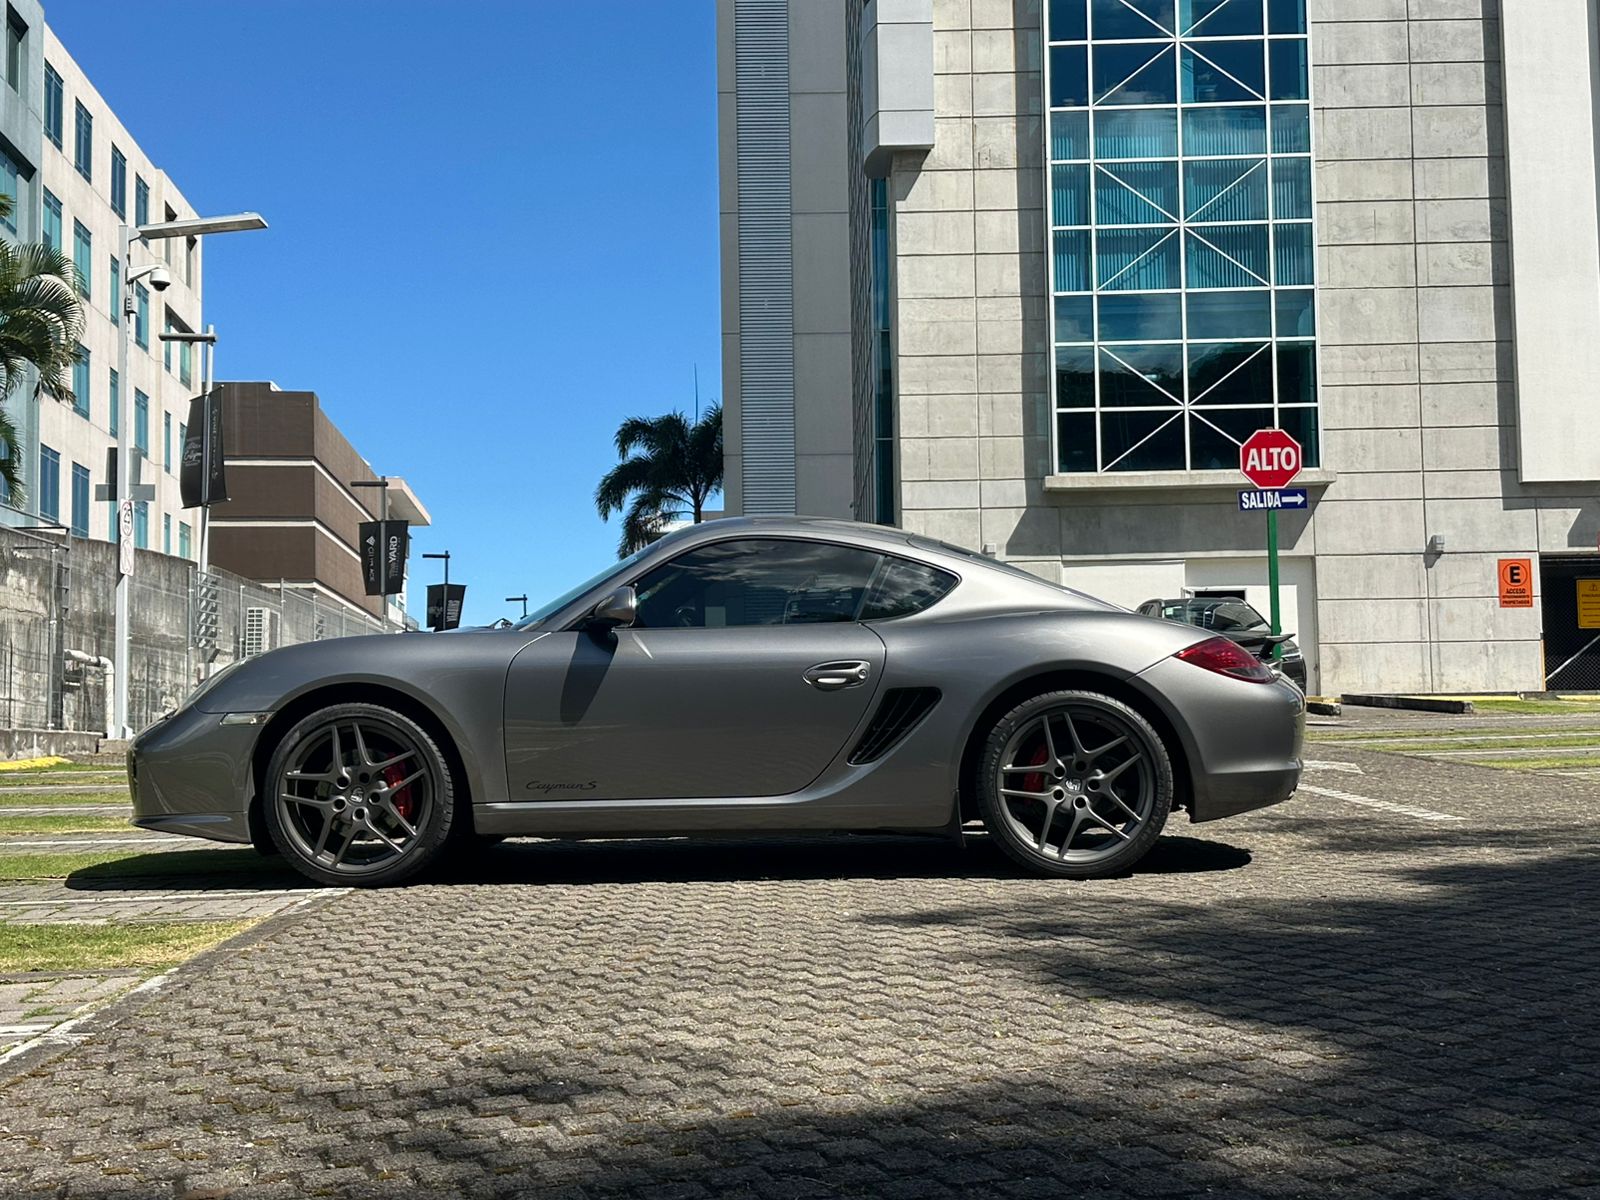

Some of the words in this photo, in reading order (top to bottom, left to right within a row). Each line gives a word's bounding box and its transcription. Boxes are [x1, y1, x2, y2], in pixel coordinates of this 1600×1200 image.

[1245, 446, 1297, 472] ALTO
[1241, 491, 1282, 509] SALIDA
[389, 536, 397, 563] YARD
[1509, 565, 1521, 583] E
